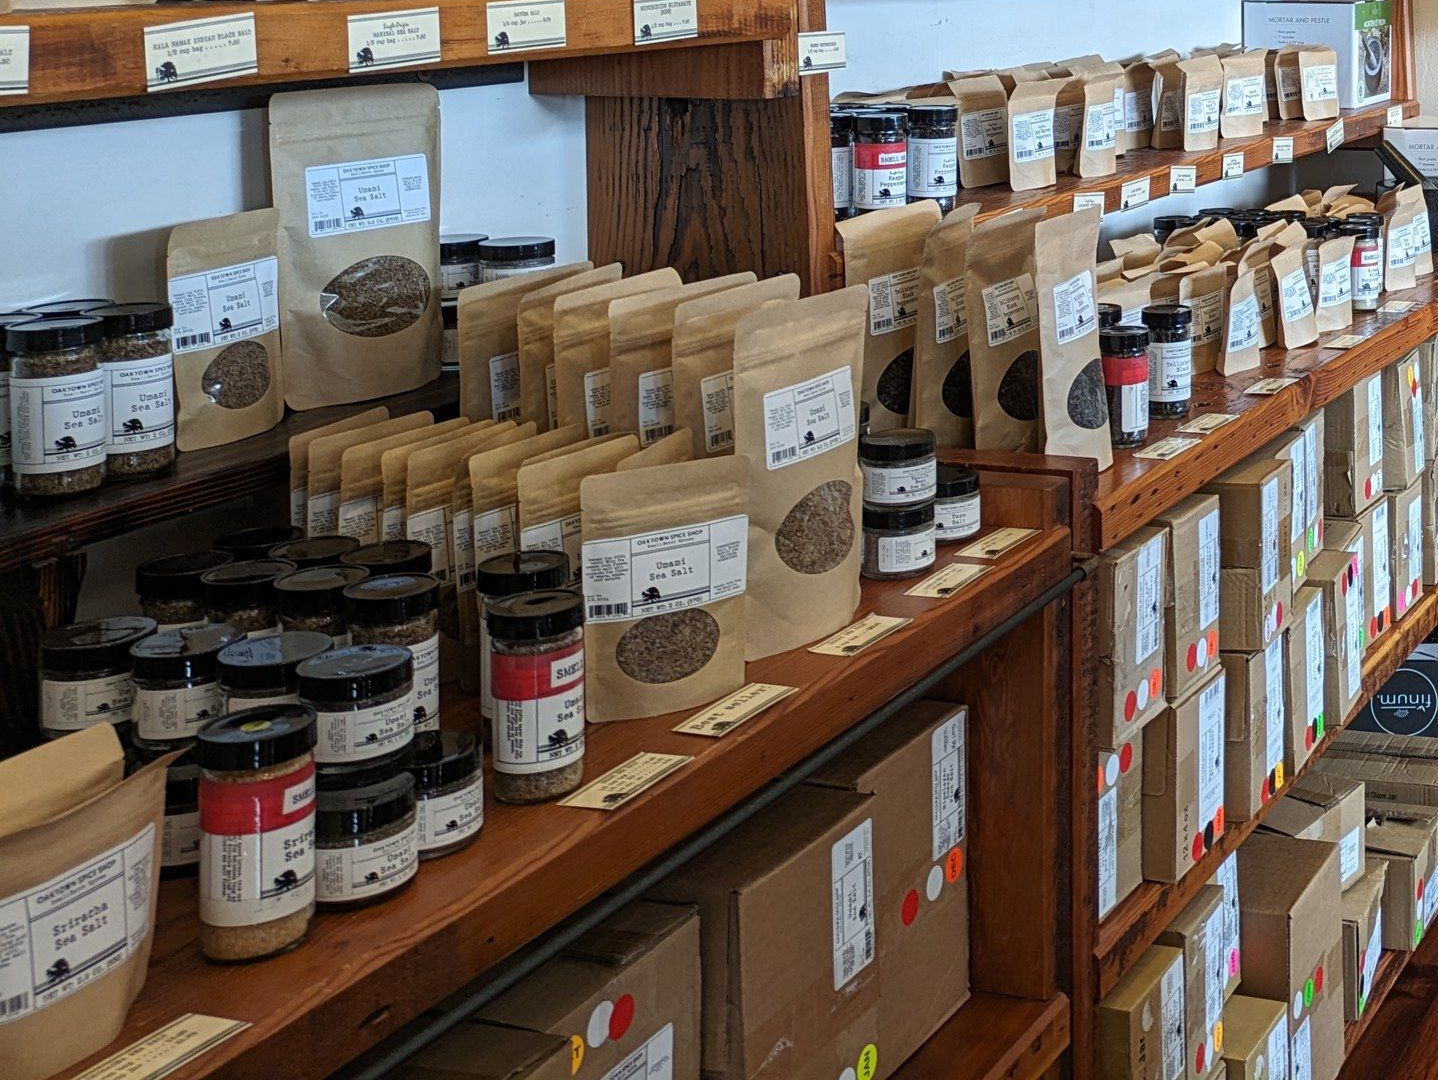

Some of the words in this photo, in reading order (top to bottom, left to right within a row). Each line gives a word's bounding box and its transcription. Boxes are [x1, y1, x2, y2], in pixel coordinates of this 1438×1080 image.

[152, 42, 170, 51] KALA
[171, 38, 193, 49] NAMAK
[194, 34, 216, 46] INDIAN
[217, 31, 236, 41] BLACK
[354, 194, 367, 202] Sea
[370, 192, 387, 200] Salt
[358, 185, 381, 195] Umami
[226, 292, 246, 303] Umami
[222, 304, 235, 312] Sea
[237, 301, 250, 311] Salt
[139, 389, 168, 402] Umami
[131, 404, 151, 413] Sea
[155, 398, 172, 409] Salt
[809, 405, 826, 417] Umami
[636, 537, 668, 547] OAKTOWN
[669, 533, 686, 542] SPICE
[687, 529, 703, 539] SHOP
[655, 558, 686, 571] Umami
[649, 570, 667, 581] Sea
[671, 565, 694, 577] Salt
[641, 606, 655, 615] NET
[557, 708, 573, 723] Sea
[949, 849, 958, 878] DEC
[36, 884, 77, 905] OAKTOWN
[78, 869, 97, 885] SPICE
[98, 858, 117, 874] SHOP
[52, 902, 108, 937] Sriracha
[54, 933, 77, 951] Sea
[81, 916, 108, 937] Salt
